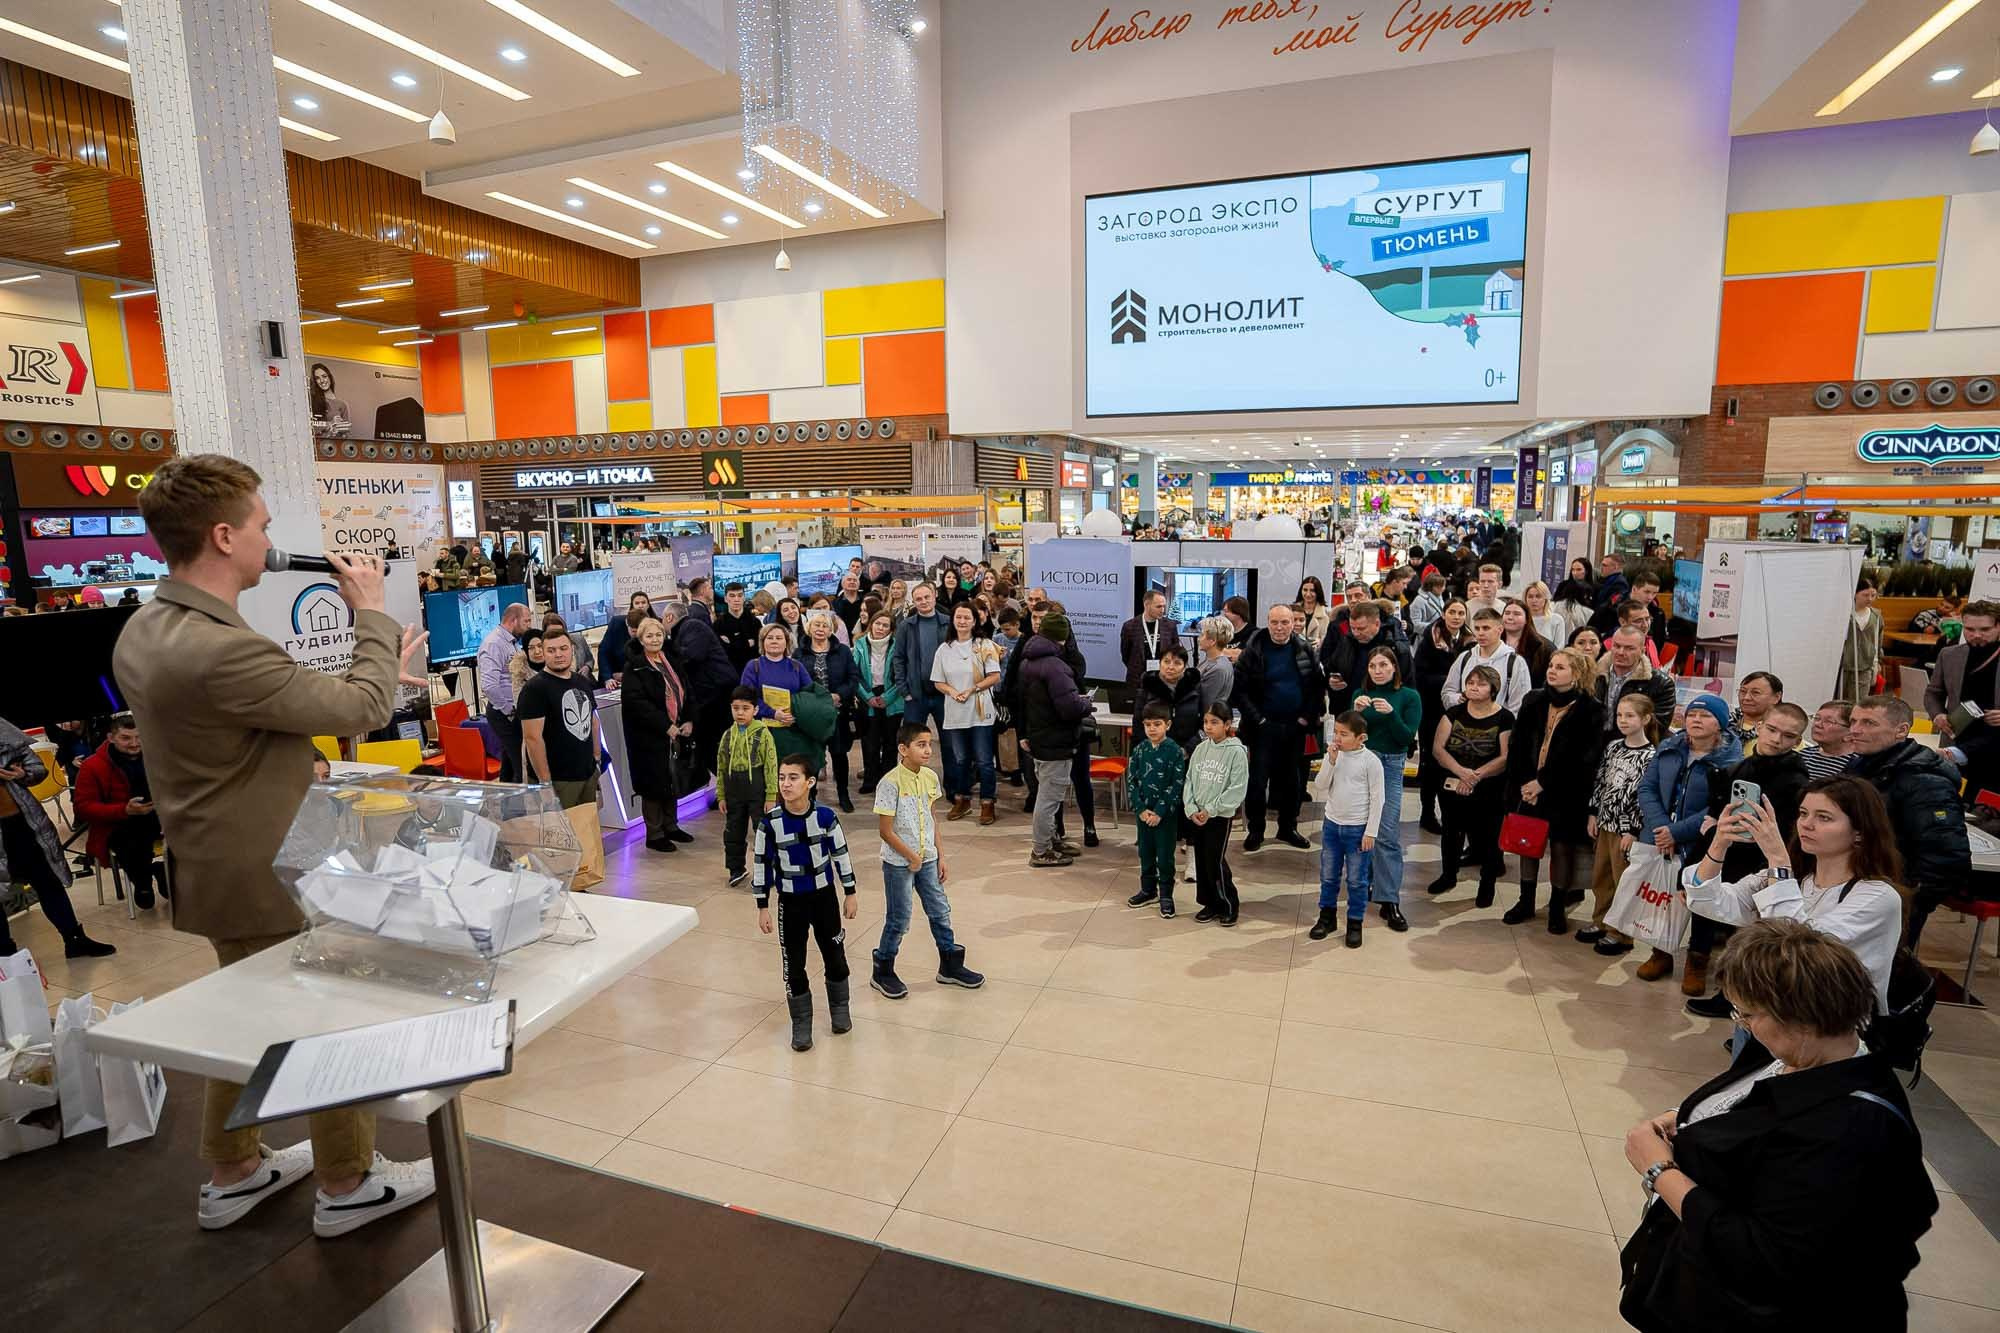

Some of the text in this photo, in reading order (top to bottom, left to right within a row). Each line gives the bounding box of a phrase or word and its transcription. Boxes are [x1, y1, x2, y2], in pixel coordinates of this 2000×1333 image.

[1072, 8, 1192, 52] Люблю
[1272, 10, 1364, 56] мой
[1374, 189, 1483, 216] СУРГУТ
[1097, 197, 1298, 231] ЗАГОРОД ЭКСПО
[1354, 215, 1394, 226] ВПЕРВЫЕ!
[1115, 220, 1279, 243] выставка загородной жизни
[1381, 226, 1480, 254] ТЮМЕНЬ
[1158, 296, 1304, 326] МОНОЛИТ
[1158, 326, 1228, 338] строительство
[1239, 322, 1305, 333] девеломпент
[1484, 368, 1507, 387] 0+
[2, 393, 75, 407] ROSTIC'S
[317, 479, 404, 495] УЛЕНЬКИ
[517, 471, 574, 487] ВКУСНО
[600, 467, 654, 483] ТОЧКА
[335, 528, 396, 545] СКОРО
[1041, 571, 1118, 585] ИСТОРИЯ
